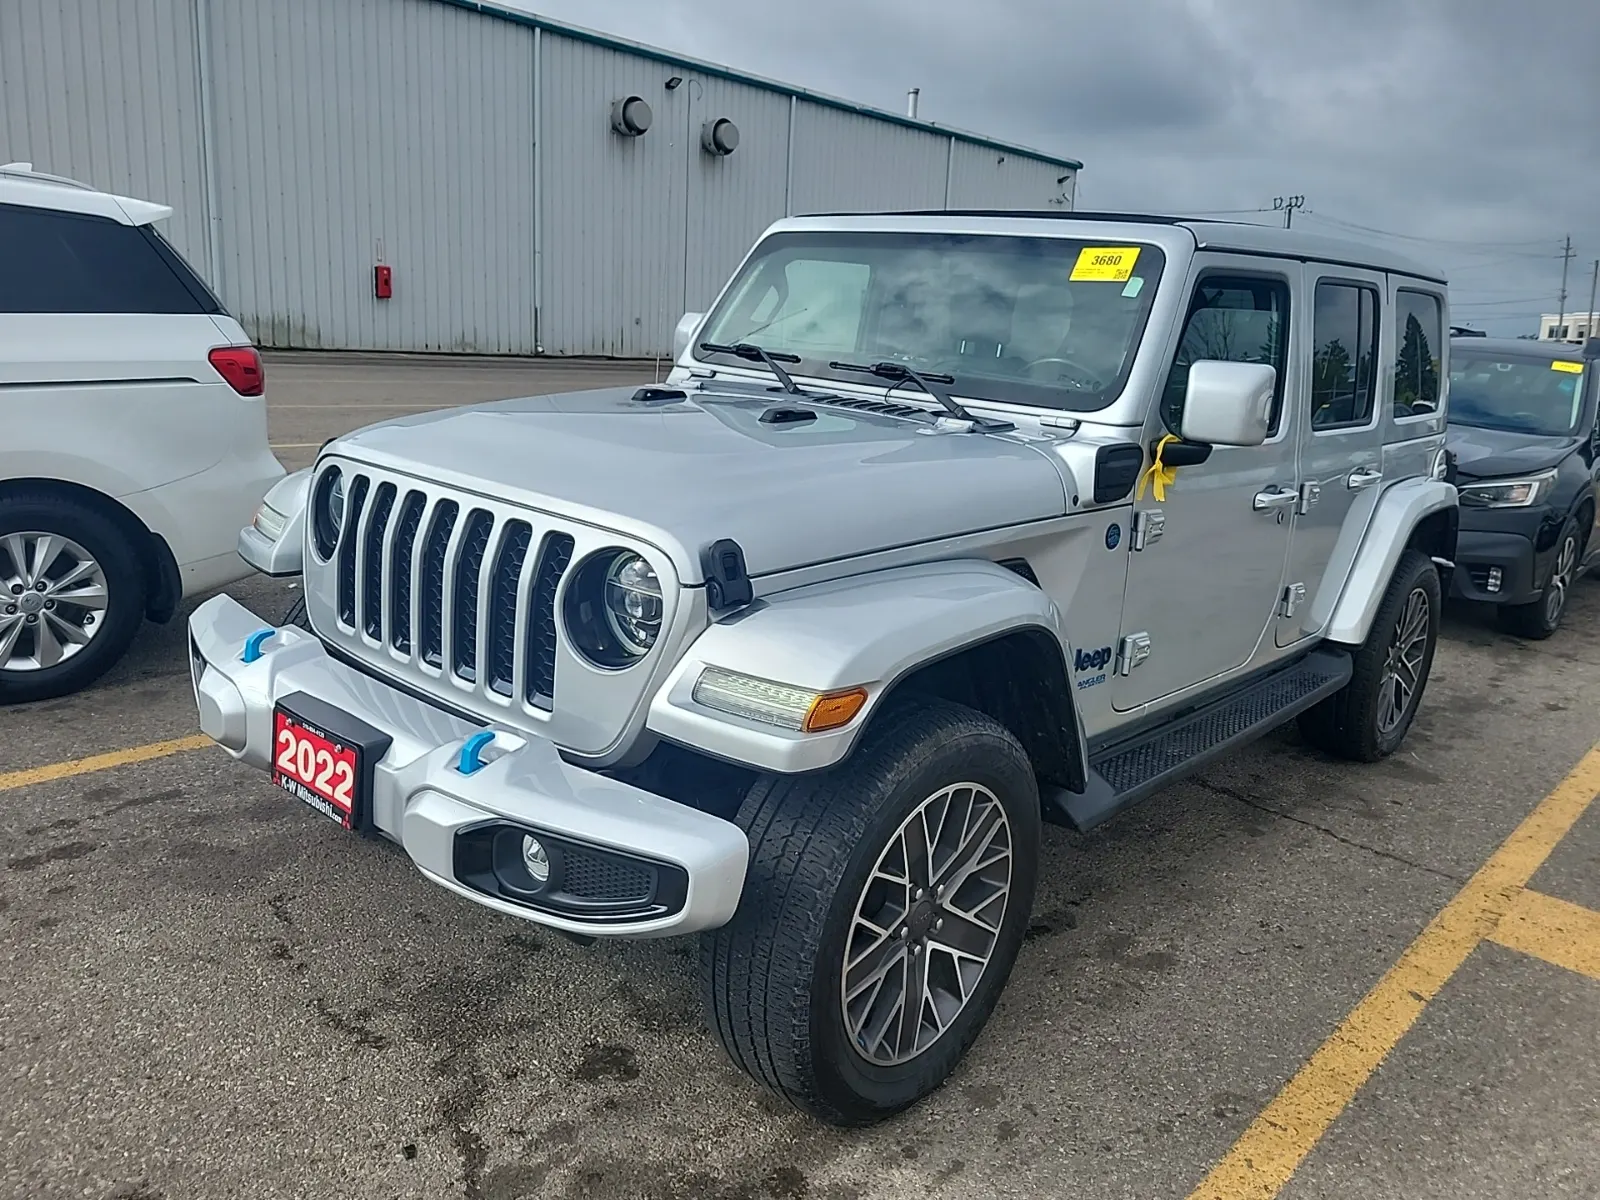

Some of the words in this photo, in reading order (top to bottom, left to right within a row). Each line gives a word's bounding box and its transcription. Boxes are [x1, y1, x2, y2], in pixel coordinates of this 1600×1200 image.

[1091, 255, 1122, 266] 3680
[1074, 646, 1112, 672] Jeep
[1077, 673, 1106, 687] ANGLER
[278, 729, 353, 808] 2022
[281, 774, 297, 794] K-W
[297, 783, 342, 824] Mitsubishi.com
